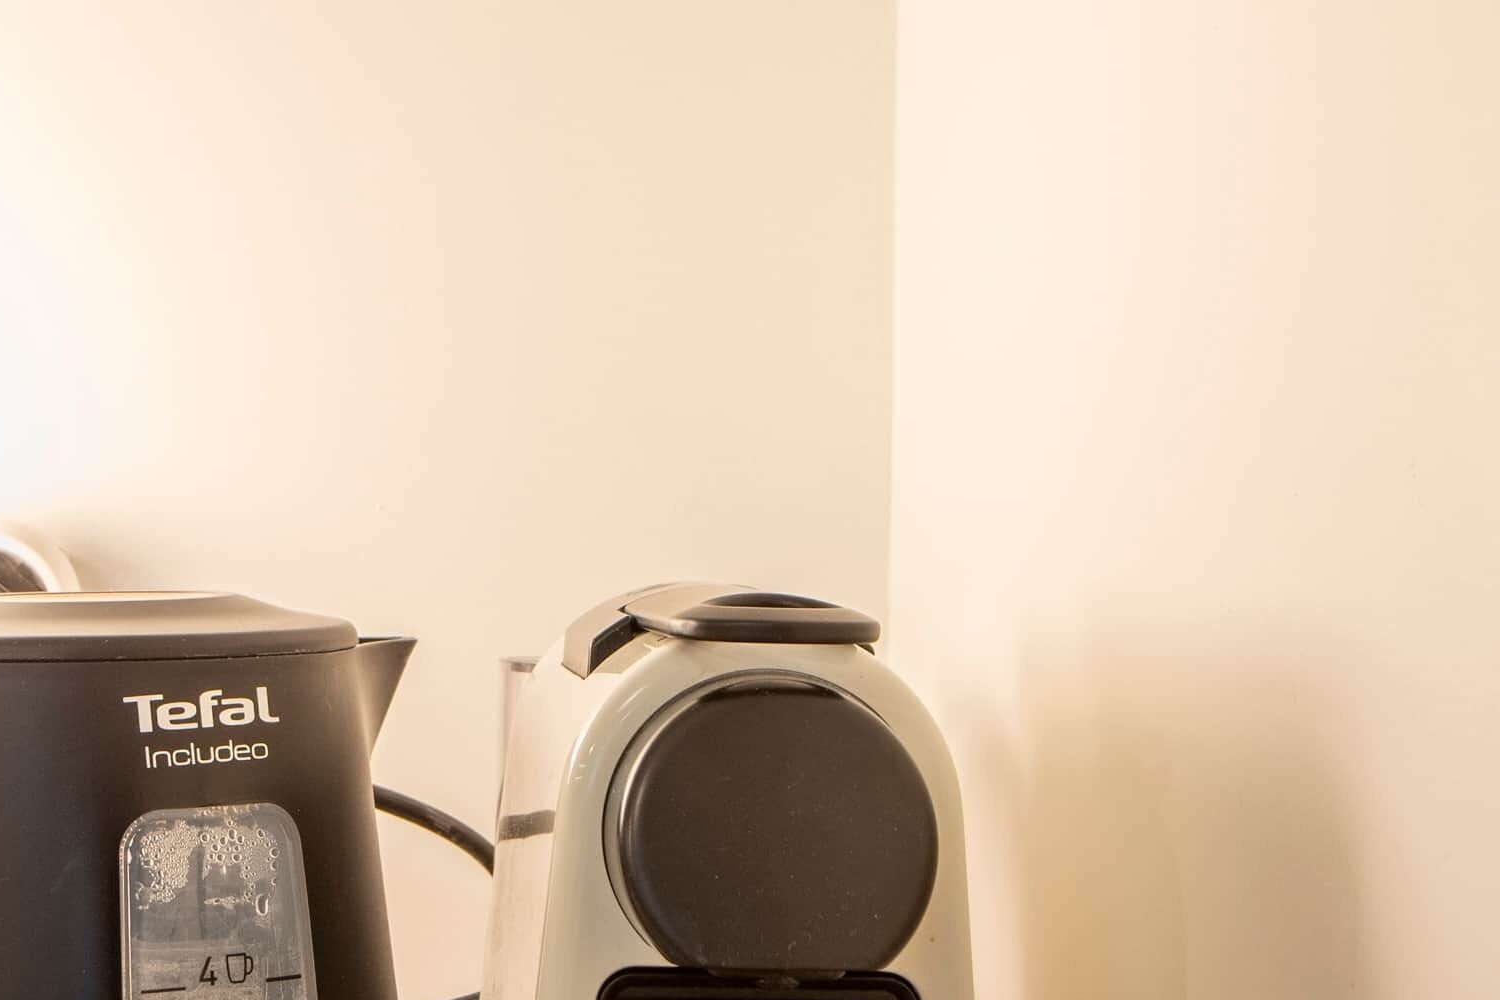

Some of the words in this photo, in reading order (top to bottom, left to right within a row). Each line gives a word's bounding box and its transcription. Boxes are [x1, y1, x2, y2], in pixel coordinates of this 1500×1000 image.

[123, 687, 280, 733] Tefal
[145, 740, 269, 769] Includeo
[200, 956, 218, 986] 4
